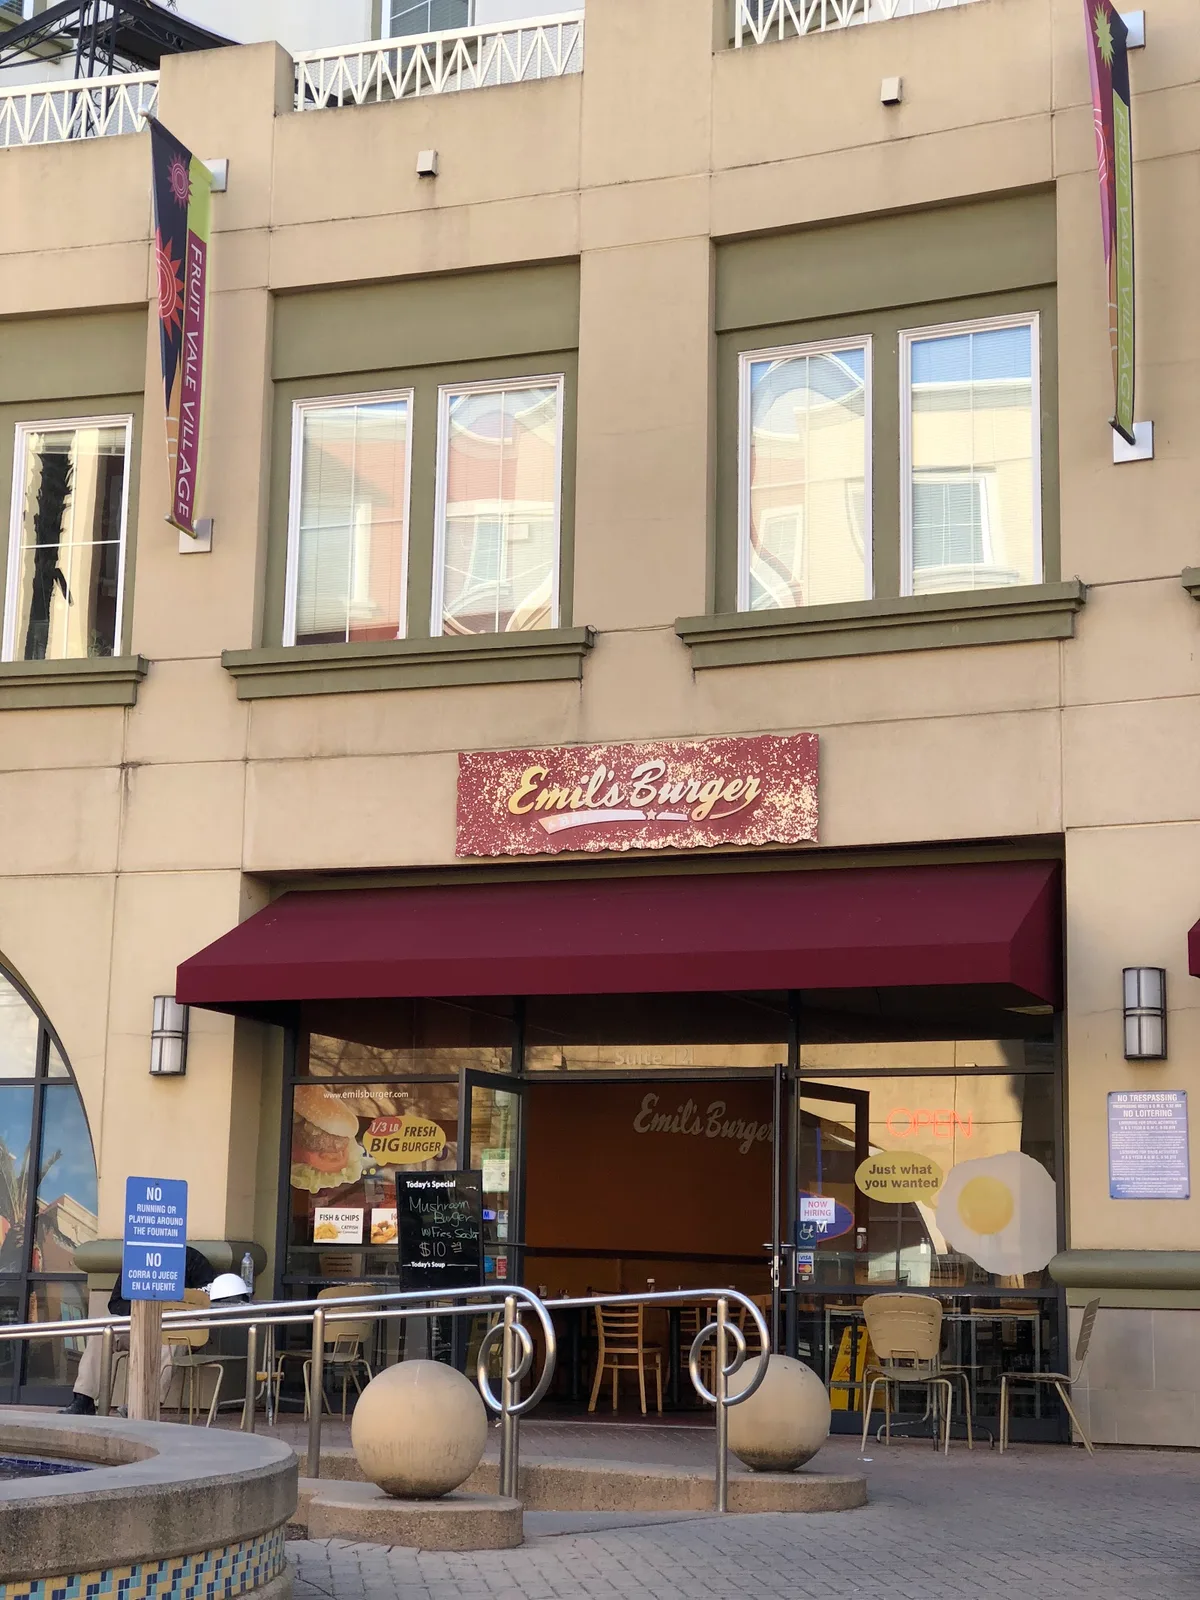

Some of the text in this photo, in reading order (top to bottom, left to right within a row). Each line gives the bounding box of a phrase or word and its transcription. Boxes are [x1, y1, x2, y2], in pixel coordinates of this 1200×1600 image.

[178, 243, 203, 518] FRUIT VALE VILLAGE
[507, 758, 762, 822] Emil's Burger
[614, 1050, 663, 1066] Suite
[323, 1089, 409, 1100] www.emilsburger.com
[1117, 1093, 1178, 1102] NO TRESPASSING
[633, 1093, 704, 1136] Emil's
[1123, 1109, 1173, 1118] NO LOITERING
[371, 1121, 400, 1133] 1/3 LB
[886, 1107, 973, 1139] OPEN
[404, 1126, 437, 1137] FRESH
[370, 1138, 441, 1152] BIG BURGER
[869, 1164, 932, 1175] Just what
[406, 1181, 456, 1190] Today's Special
[865, 1178, 939, 1190] you wanted
[146, 1187, 162, 1201] NO
[137, 1204, 176, 1214] RUNNING OR
[409, 1196, 470, 1213] Mushroom
[128, 1215, 184, 1226] PLAYING AROUND
[133, 1226, 178, 1237] THE FOUNTAIN
[419, 1241, 446, 1257] $10
[146, 1253, 162, 1267] NO
[128, 1270, 178, 1280] CORRA O JUEGE
[132, 1282, 176, 1291] EN LA FUENTE
